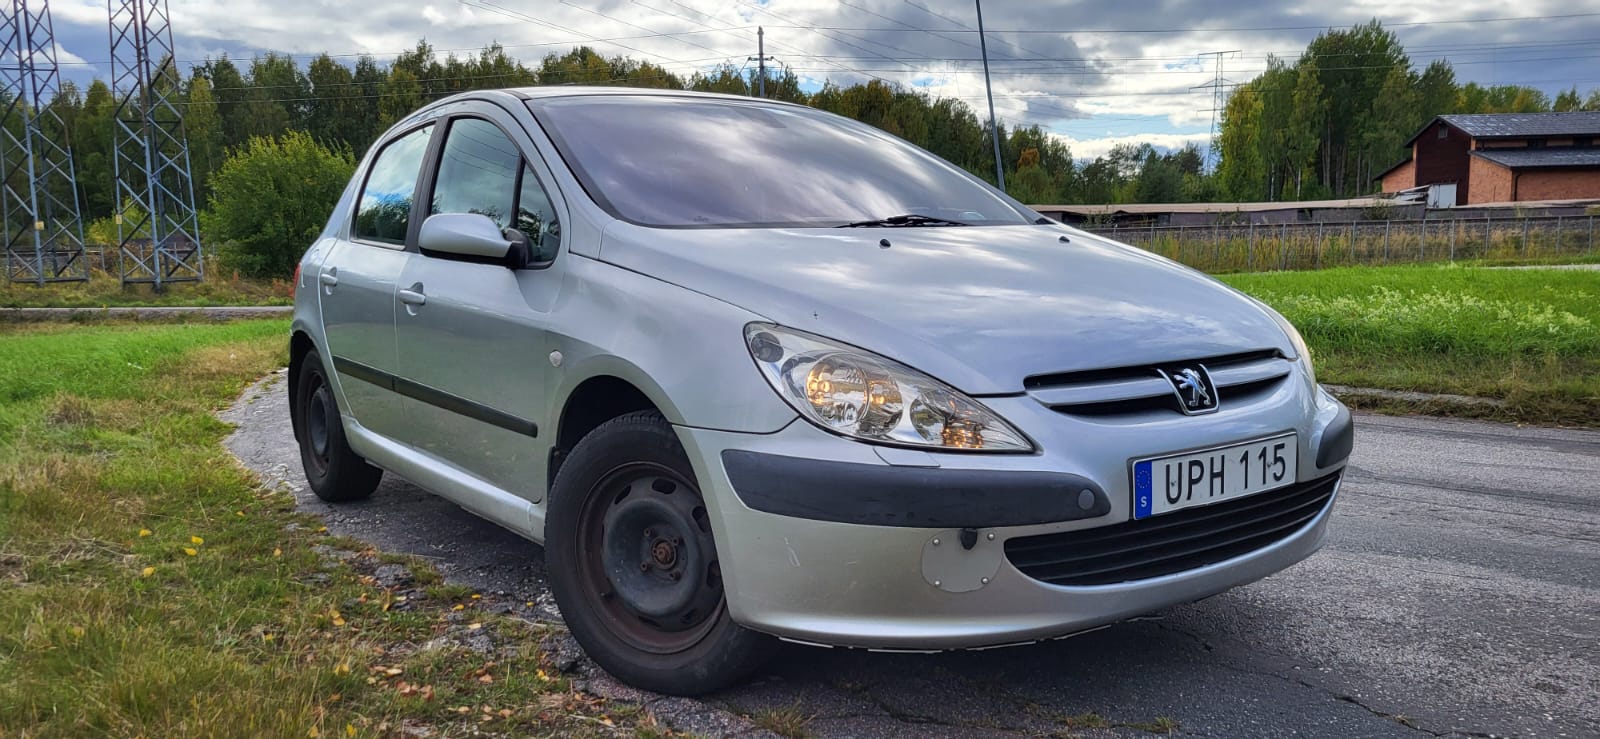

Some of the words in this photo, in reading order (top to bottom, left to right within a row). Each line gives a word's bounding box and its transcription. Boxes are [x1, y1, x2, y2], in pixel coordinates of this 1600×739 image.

[1165, 455, 1225, 504] UPH
[1239, 443, 1286, 490] 115
[1140, 496, 1148, 508] S
